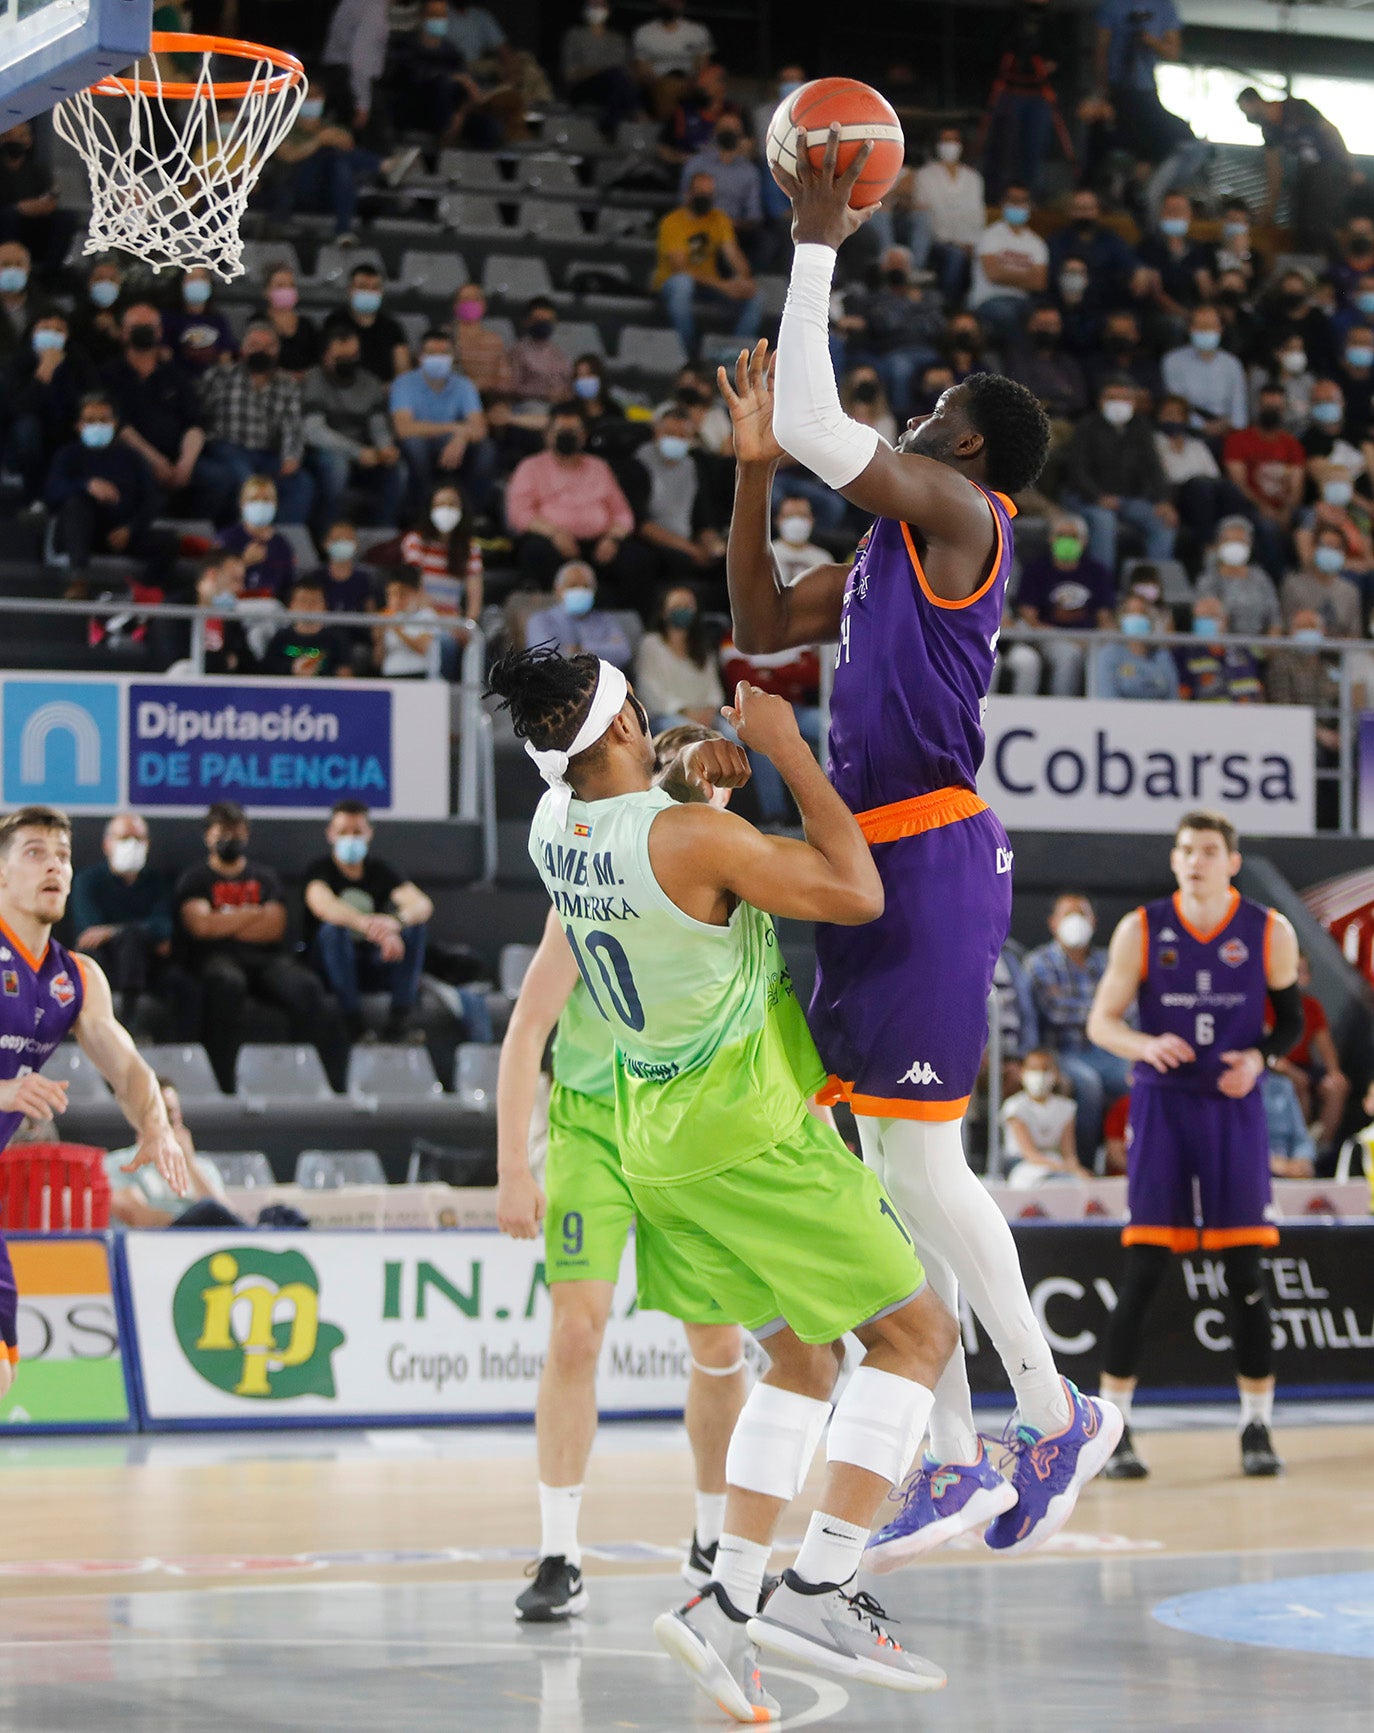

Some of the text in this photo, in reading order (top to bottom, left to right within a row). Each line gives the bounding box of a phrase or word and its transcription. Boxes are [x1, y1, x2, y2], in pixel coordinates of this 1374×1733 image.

[137, 701, 338, 745] Diputación
[138, 752, 386, 790] DE PALENCIA
[994, 728, 1296, 802] Cobarsa
[565, 923, 646, 1033] 10
[1195, 1013, 1215, 1046] 6
[562, 1210, 584, 1256] 9
[1193, 1307, 1374, 1352] CSTILL
[386, 1342, 469, 1392] Grupo
